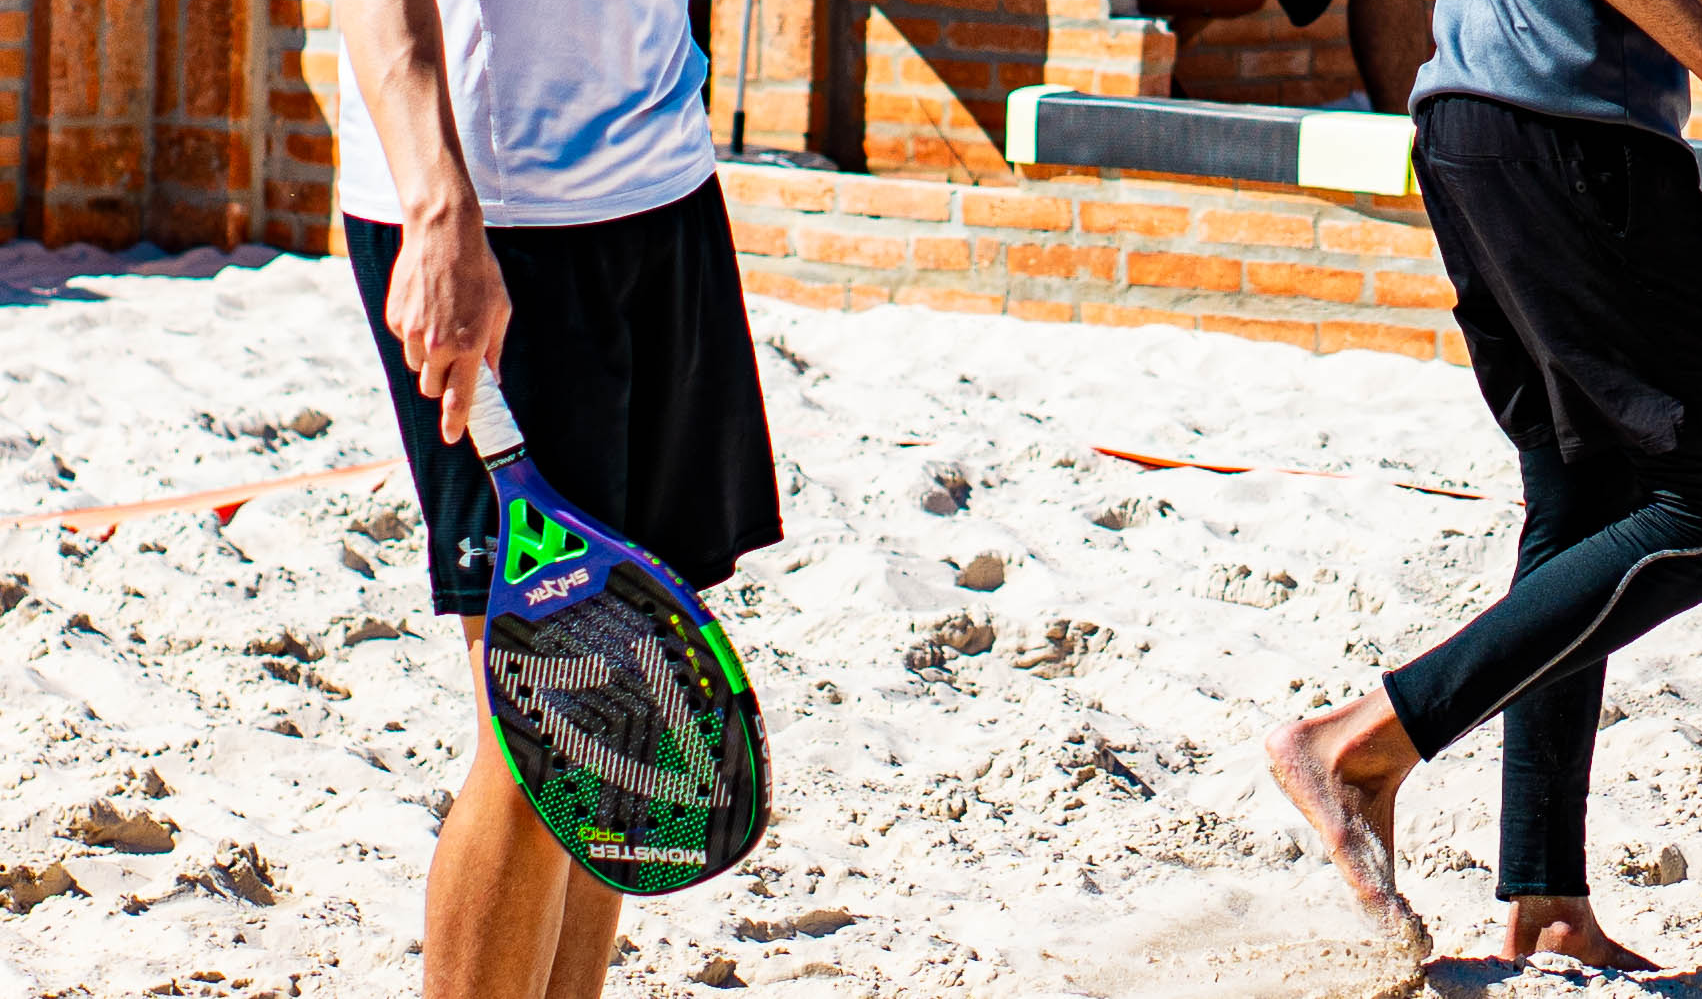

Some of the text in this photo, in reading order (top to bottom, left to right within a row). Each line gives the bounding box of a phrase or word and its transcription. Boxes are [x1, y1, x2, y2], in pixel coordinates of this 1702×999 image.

[525, 567, 590, 607] SHARK
[578, 825, 625, 842] PRO
[588, 843, 707, 865] MONSTER
